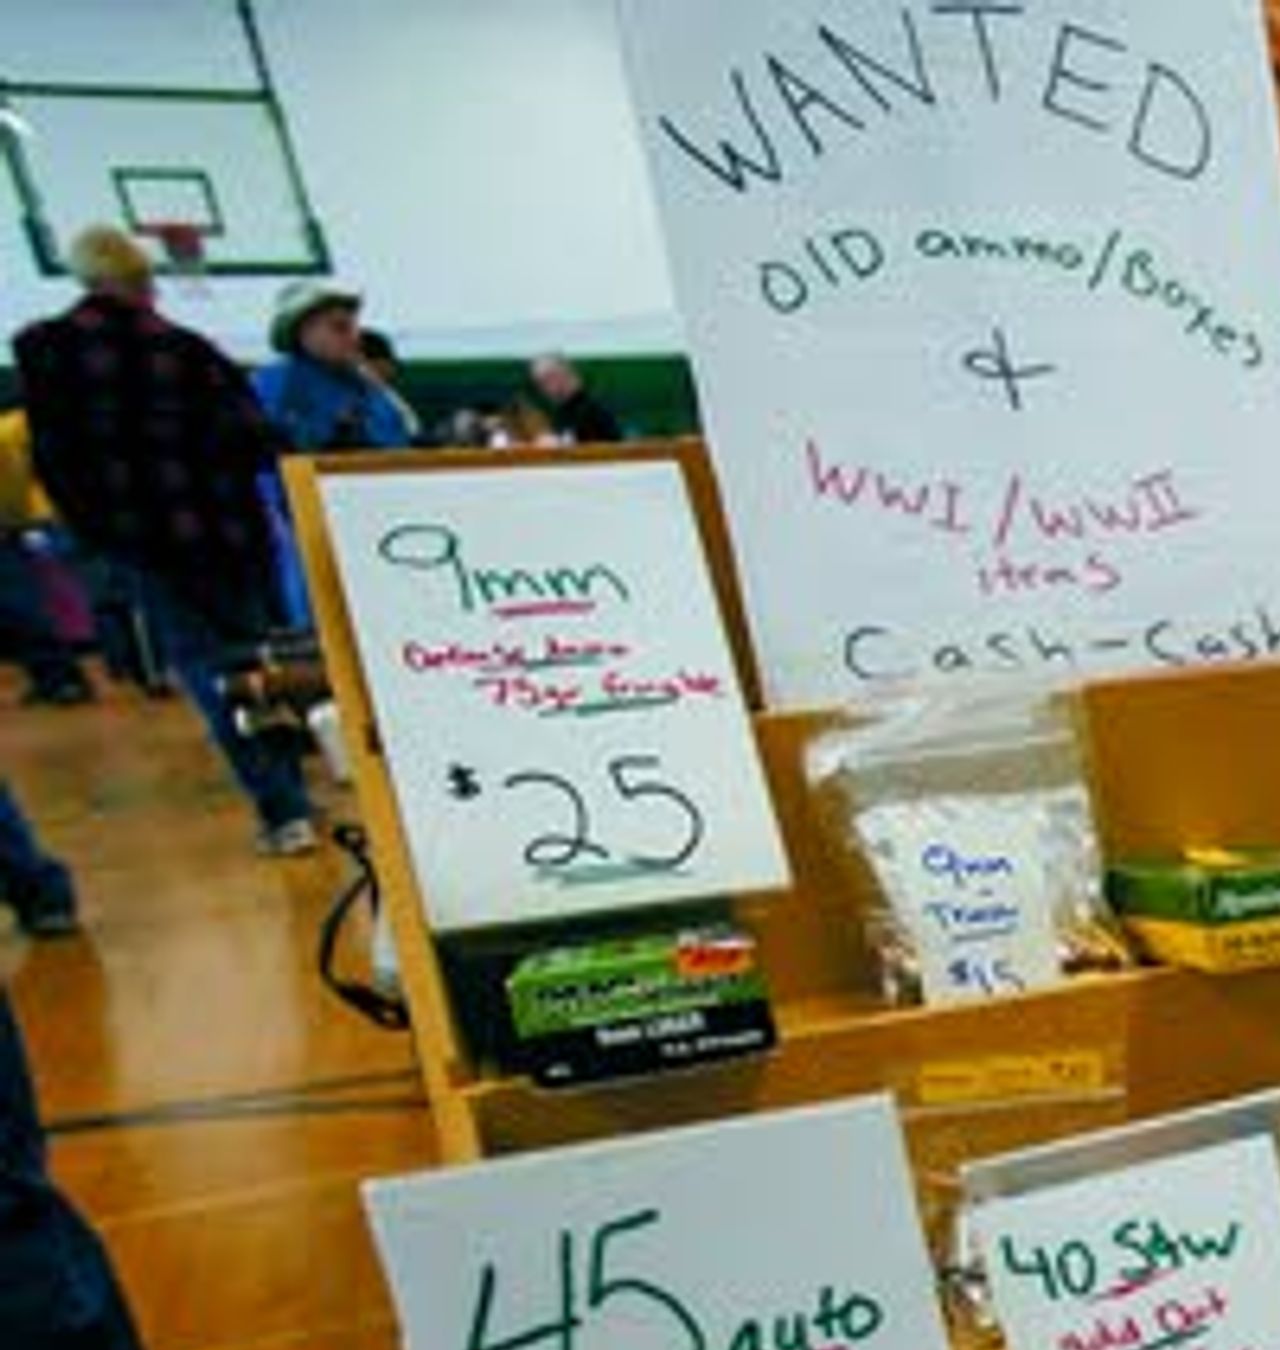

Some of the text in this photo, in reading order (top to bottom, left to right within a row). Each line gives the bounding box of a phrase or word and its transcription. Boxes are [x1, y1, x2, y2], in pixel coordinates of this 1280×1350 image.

[658, 3, 1212, 192] WANTED
[377, 523, 630, 611] 9mm
[446, 755, 705, 871] $25
[1000, 1234, 1098, 1300] 40
